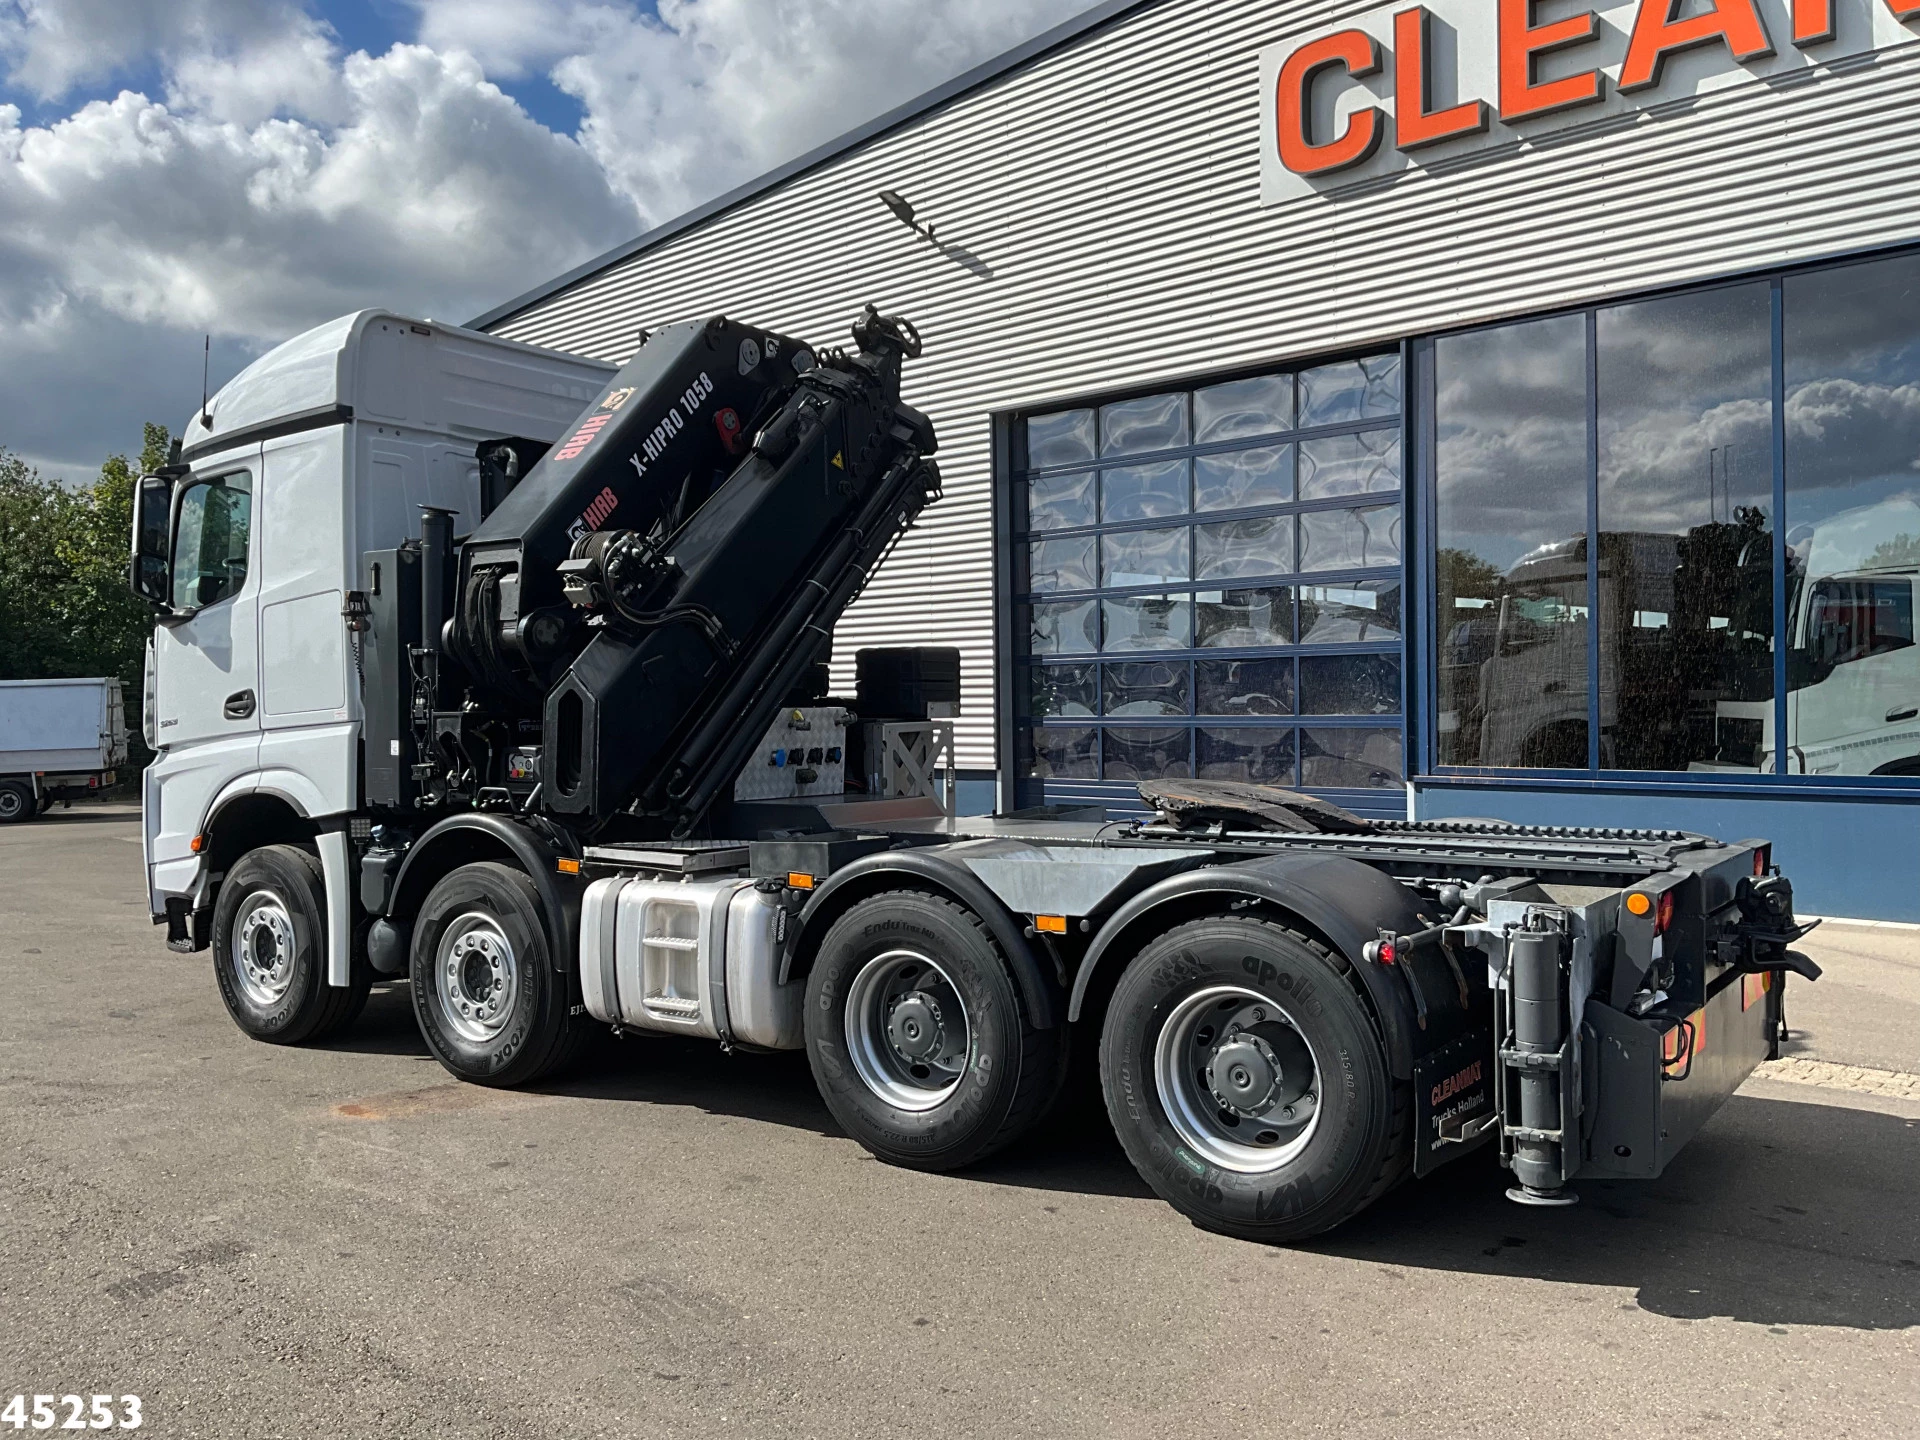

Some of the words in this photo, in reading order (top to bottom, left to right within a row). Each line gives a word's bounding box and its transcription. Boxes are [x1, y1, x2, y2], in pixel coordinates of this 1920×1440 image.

[554, 413, 613, 461] HIAB
[629, 408, 684, 477] X-HIPRO
[680, 371, 714, 415] 1058
[583, 486, 618, 531] HIAB
[1431, 1060, 1482, 1106] CLEANMAT
[1457, 1088, 1485, 1113] Holland
